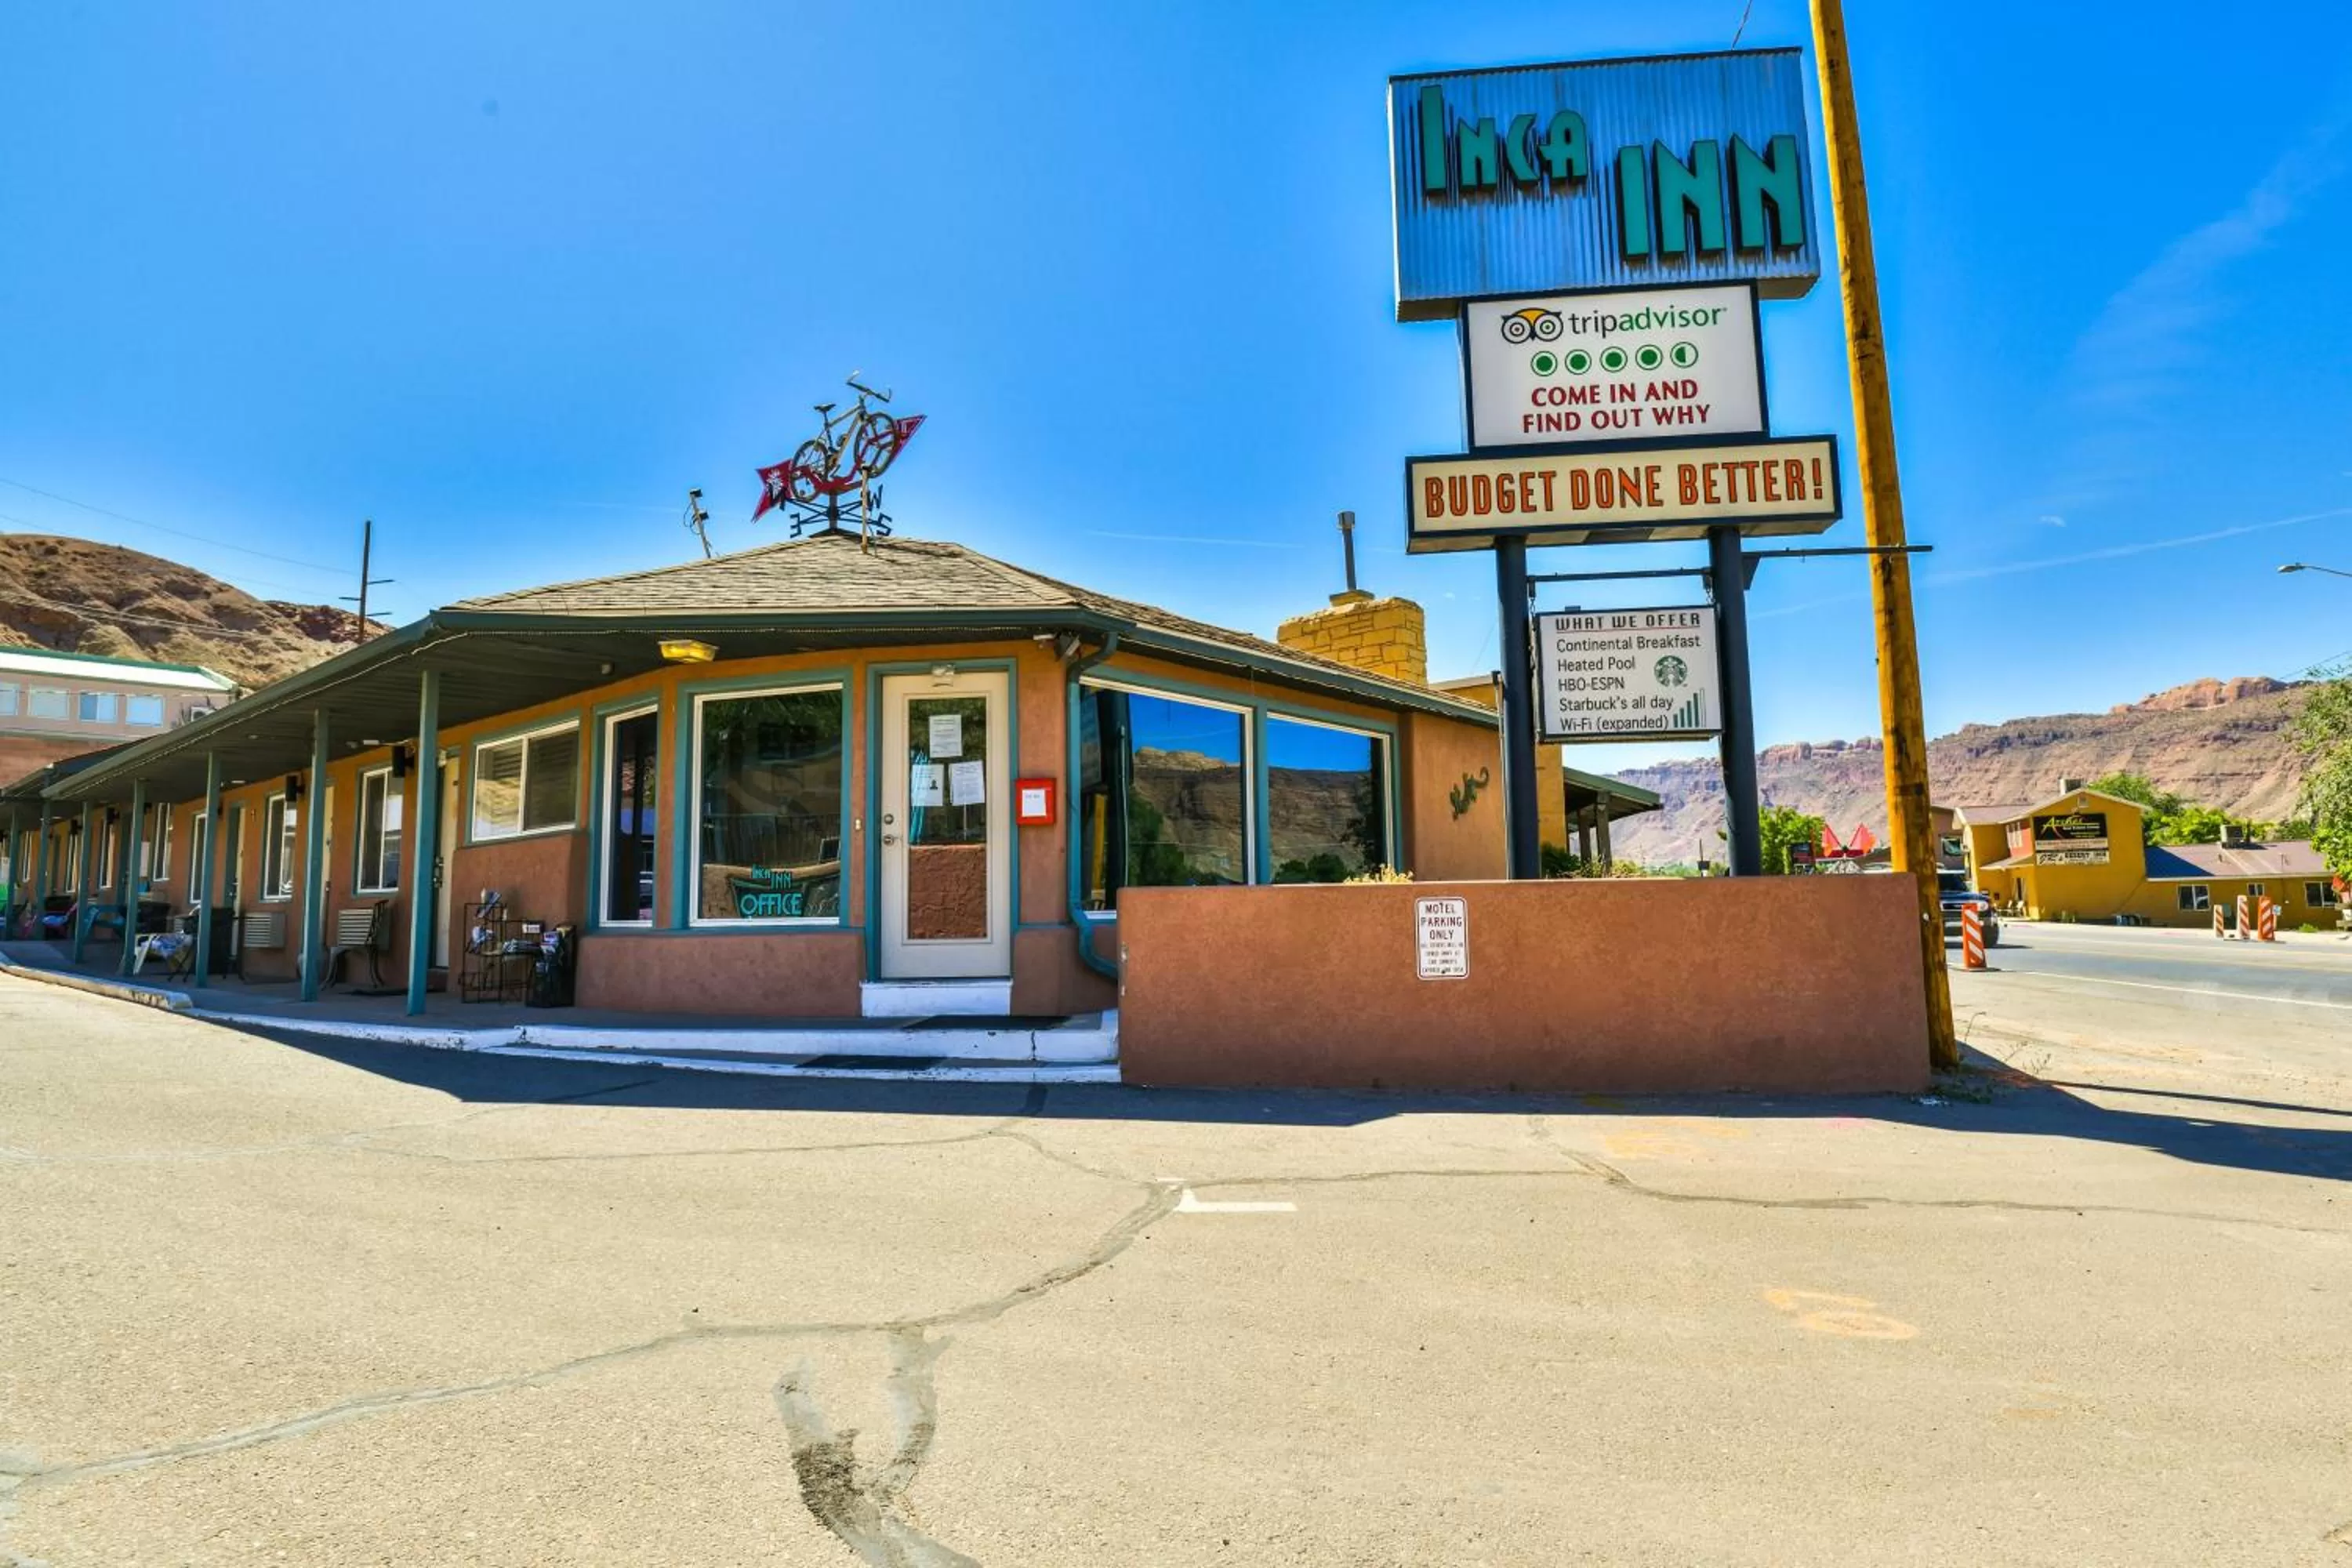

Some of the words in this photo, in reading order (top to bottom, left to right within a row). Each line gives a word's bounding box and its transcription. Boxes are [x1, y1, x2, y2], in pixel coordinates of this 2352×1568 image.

[1615, 133, 1803, 260] INN
[1567, 306, 1722, 339] tripadvisor
[1531, 385, 1601, 408] COME
[1610, 383, 1637, 403] IN
[1645, 379, 1699, 401] AND
[1523, 412, 1581, 434] FIND
[1591, 408, 1643, 430] OUT
[1652, 405, 1711, 426] WHY
[1425, 471, 1558, 518] BUDGET
[1570, 466, 1664, 510] DONE
[1679, 457, 1824, 506] BETTER!
[1555, 616, 1605, 630] WHAT
[1612, 615, 1638, 628] WE
[1646, 612, 1701, 627] OFFER
[1556, 637, 1633, 652] Continental
[1636, 634, 1701, 649] Breakfast
[1558, 659, 1603, 673] Heated
[1608, 656, 1635, 670] Pool
[1558, 677, 1625, 691] HBO-ESPN
[1559, 695, 1628, 713] Starbuck's
[1632, 695, 1646, 709] all
[1650, 695, 1674, 711] day
[1560, 717, 1592, 731] Wi-Fi
[1596, 714, 1669, 731] (expanded)
[771, 871, 792, 891] INN
[740, 892, 803, 916] OFFICE
[1425, 902, 1456, 914] MOTEL
[1421, 916, 1462, 927] PARKING
[1429, 929, 1454, 940] ONLY
